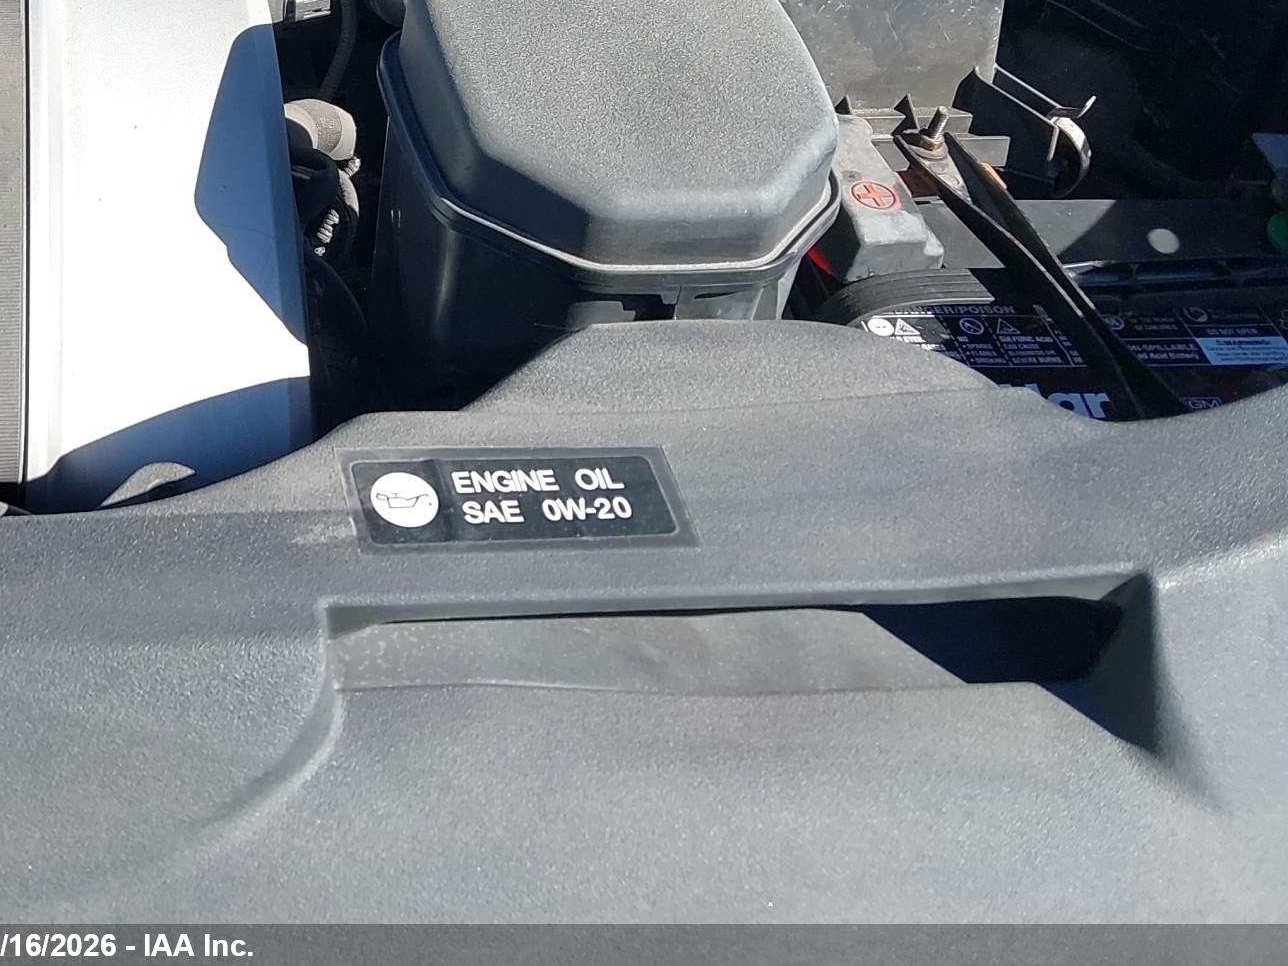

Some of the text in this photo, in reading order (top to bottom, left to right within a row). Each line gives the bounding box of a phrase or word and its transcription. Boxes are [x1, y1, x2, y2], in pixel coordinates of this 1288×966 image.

[451, 467, 625, 494] ENGINE OIL
[462, 496, 633, 524] SAE 0W-20
